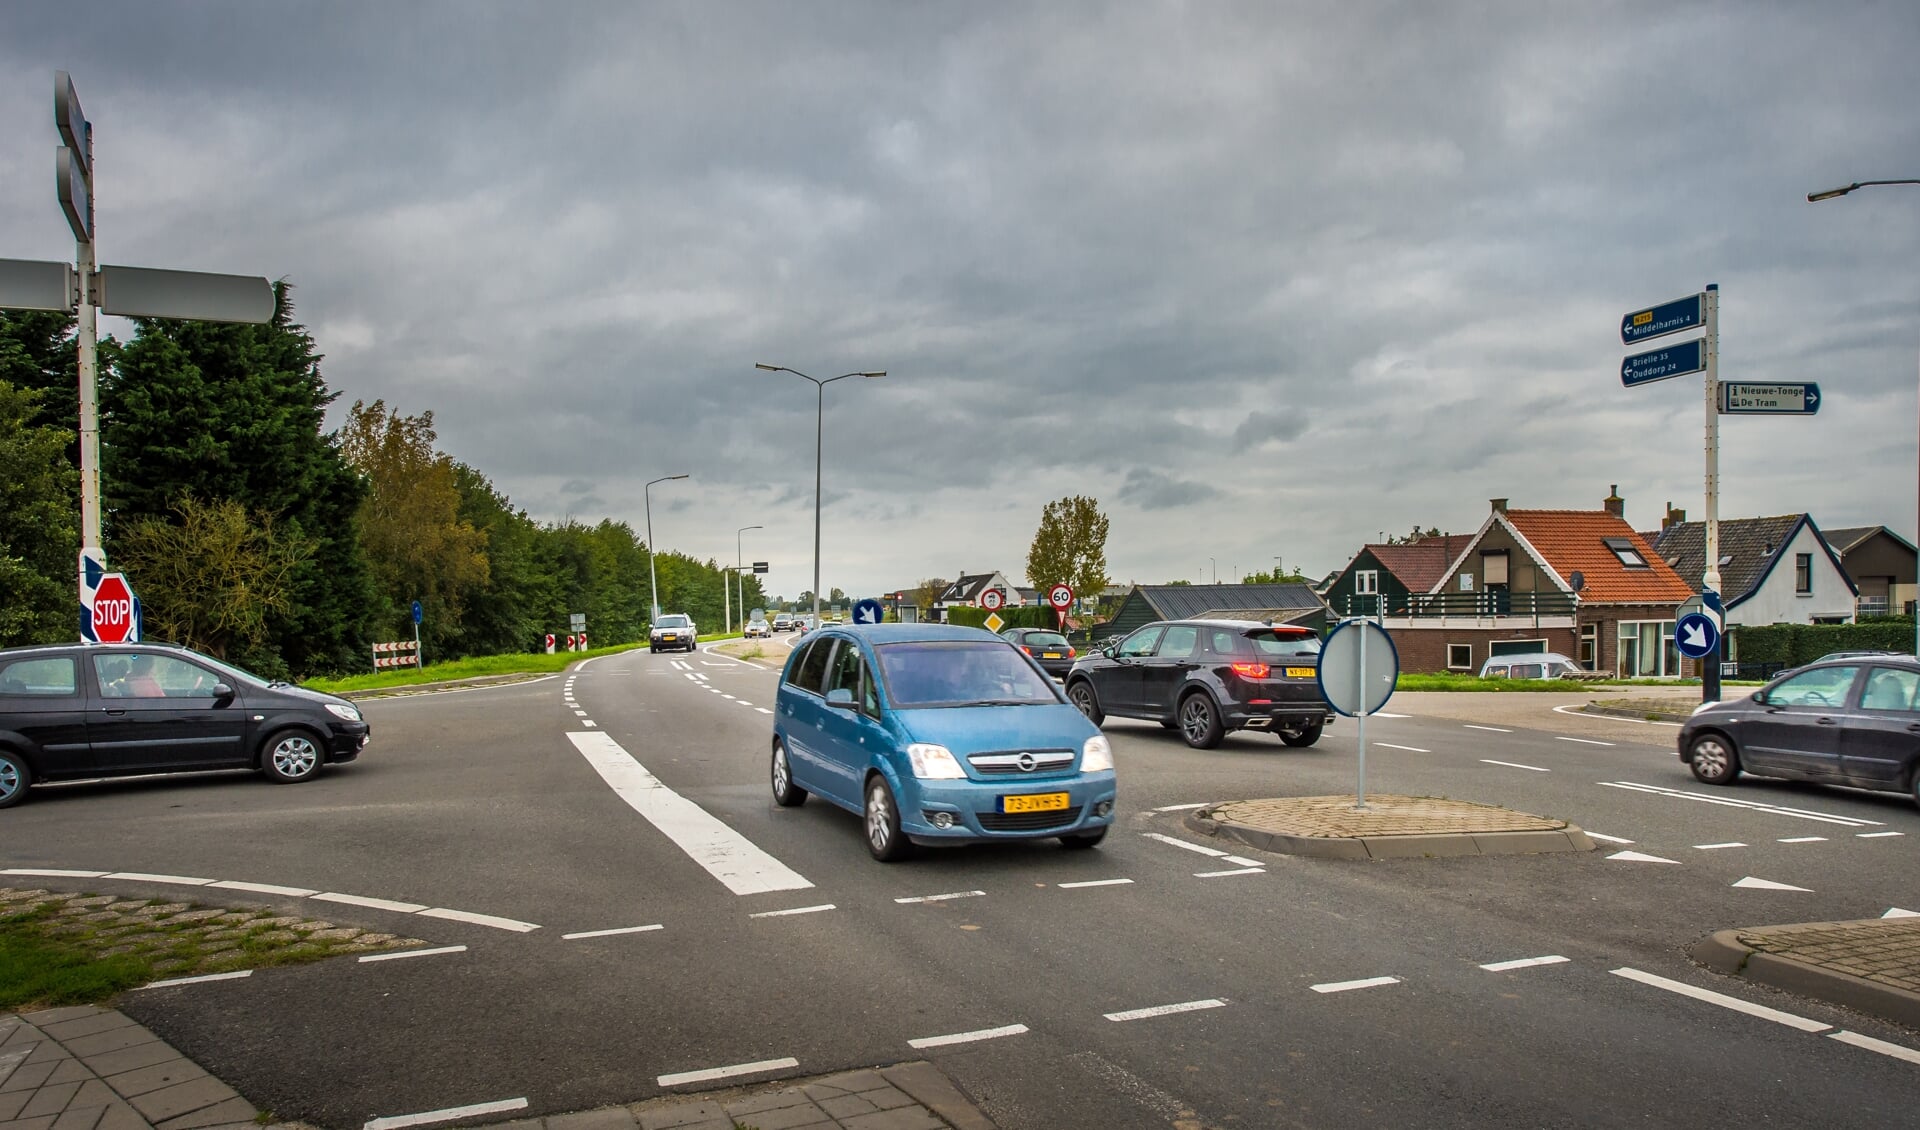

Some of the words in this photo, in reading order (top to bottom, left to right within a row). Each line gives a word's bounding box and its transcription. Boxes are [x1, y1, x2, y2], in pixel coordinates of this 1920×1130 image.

[1632, 316, 1684, 336] Middelharnis
[1685, 314, 1691, 322] 4
[1634, 313, 1652, 324] N215
[1632, 354, 1658, 367] Brielle
[1660, 352, 1669, 361] 35
[1632, 366, 1666, 379] Ouddorp
[1667, 363, 1676, 371] 24
[1741, 386, 1804, 397] Nieuwe-Tonge
[1741, 399, 1753, 407] De
[1755, 399, 1777, 407] Tram
[1053, 591, 1069, 602] 60
[94, 599, 130, 626] STOP
